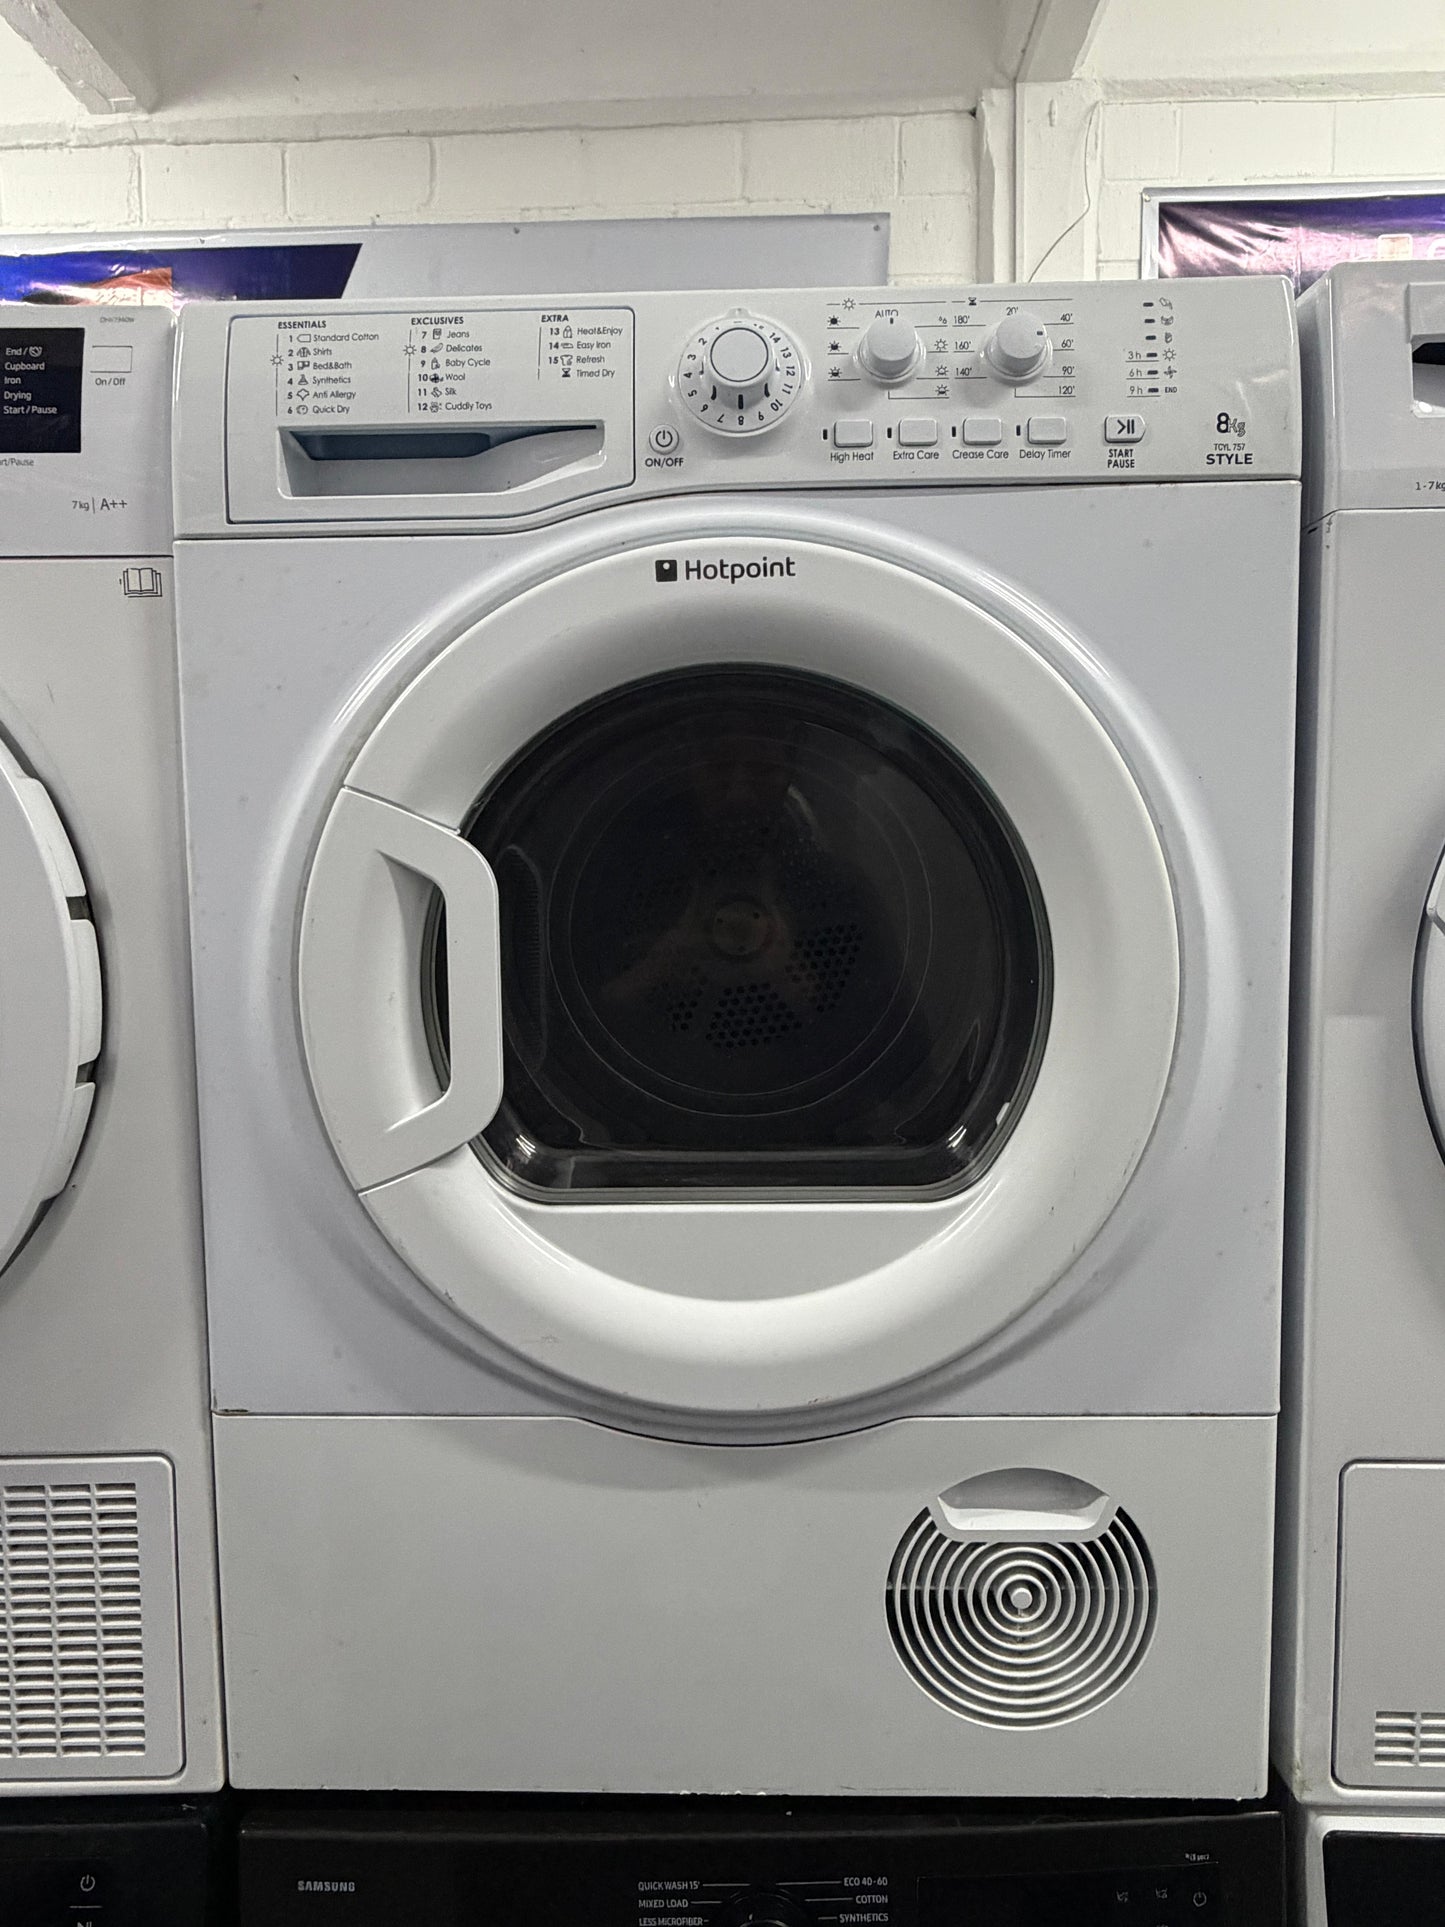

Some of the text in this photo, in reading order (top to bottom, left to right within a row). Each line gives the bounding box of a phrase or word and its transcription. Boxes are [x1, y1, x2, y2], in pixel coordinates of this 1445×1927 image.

[410, 316, 465, 325] EXCLUSIVES
[541, 314, 569, 323] EXTRA
[278, 320, 327, 330] ESSENTIALS
[421, 331, 470, 340] 7 Jeans
[549, 326, 624, 336] 13 Heat&Enjoy
[288, 332, 380, 343] 1 Standard Cotton
[697, 337, 708, 346] 2
[768, 332, 782, 344] 14
[420, 343, 483, 353] 8 Delicates
[548, 340, 612, 350] 14 Easy Iron
[5, 348, 22, 356] End
[287, 347, 333, 357] 2 Shirts
[687, 353, 697, 361] 3
[780, 347, 793, 359] 13
[420, 357, 491, 368] 9 Baby Cycle
[548, 354, 606, 365] 15 Refresh
[4, 362, 45, 372] Cupboard
[287, 361, 353, 372] 3 Bed&Bath
[785, 365, 796, 377] 12
[418, 372, 466, 382] 10 Wool
[576, 368, 616, 379] Timed Dry
[683, 371, 693, 379] 4
[4, 377, 21, 385] Iron
[287, 376, 352, 386] 4 Synthetics
[417, 386, 457, 397] 11 Silk
[687, 389, 698, 398] 5
[782, 383, 794, 395] 11
[1164, 386, 1178, 394] END
[3, 392, 32, 401] Drying
[287, 390, 357, 401] 5 Anti Allergy
[287, 404, 351, 415] 6 Quick Dry
[417, 401, 493, 411] 12 Cuddly Toys
[770, 398, 784, 412] 10
[716, 413, 725, 424] 7
[737, 415, 745, 426] 8
[1232, 443, 1246, 452] 757
[830, 452, 874, 464] High Heat
[893, 450, 940, 460] Extra Care
[952, 449, 1010, 460] Crease Care
[1019, 449, 1071, 460] Delay Timer
[1108, 448, 1134, 458] START
[644, 457, 685, 469] ON/OFF
[1107, 459, 1136, 469] PAUSE
[1206, 453, 1254, 465] STYLE
[685, 556, 796, 585] Hotpoint
[297, 1880, 356, 1892] SAMSUNG
[843, 1877, 860, 1887] ECO
[638, 1899, 689, 1909] MIXED LOAD
[855, 1895, 889, 1904] COTTON
[639, 1917, 704, 1927] LESS MICROFIBER
[839, 1913, 889, 1923] SYNTHETICS
